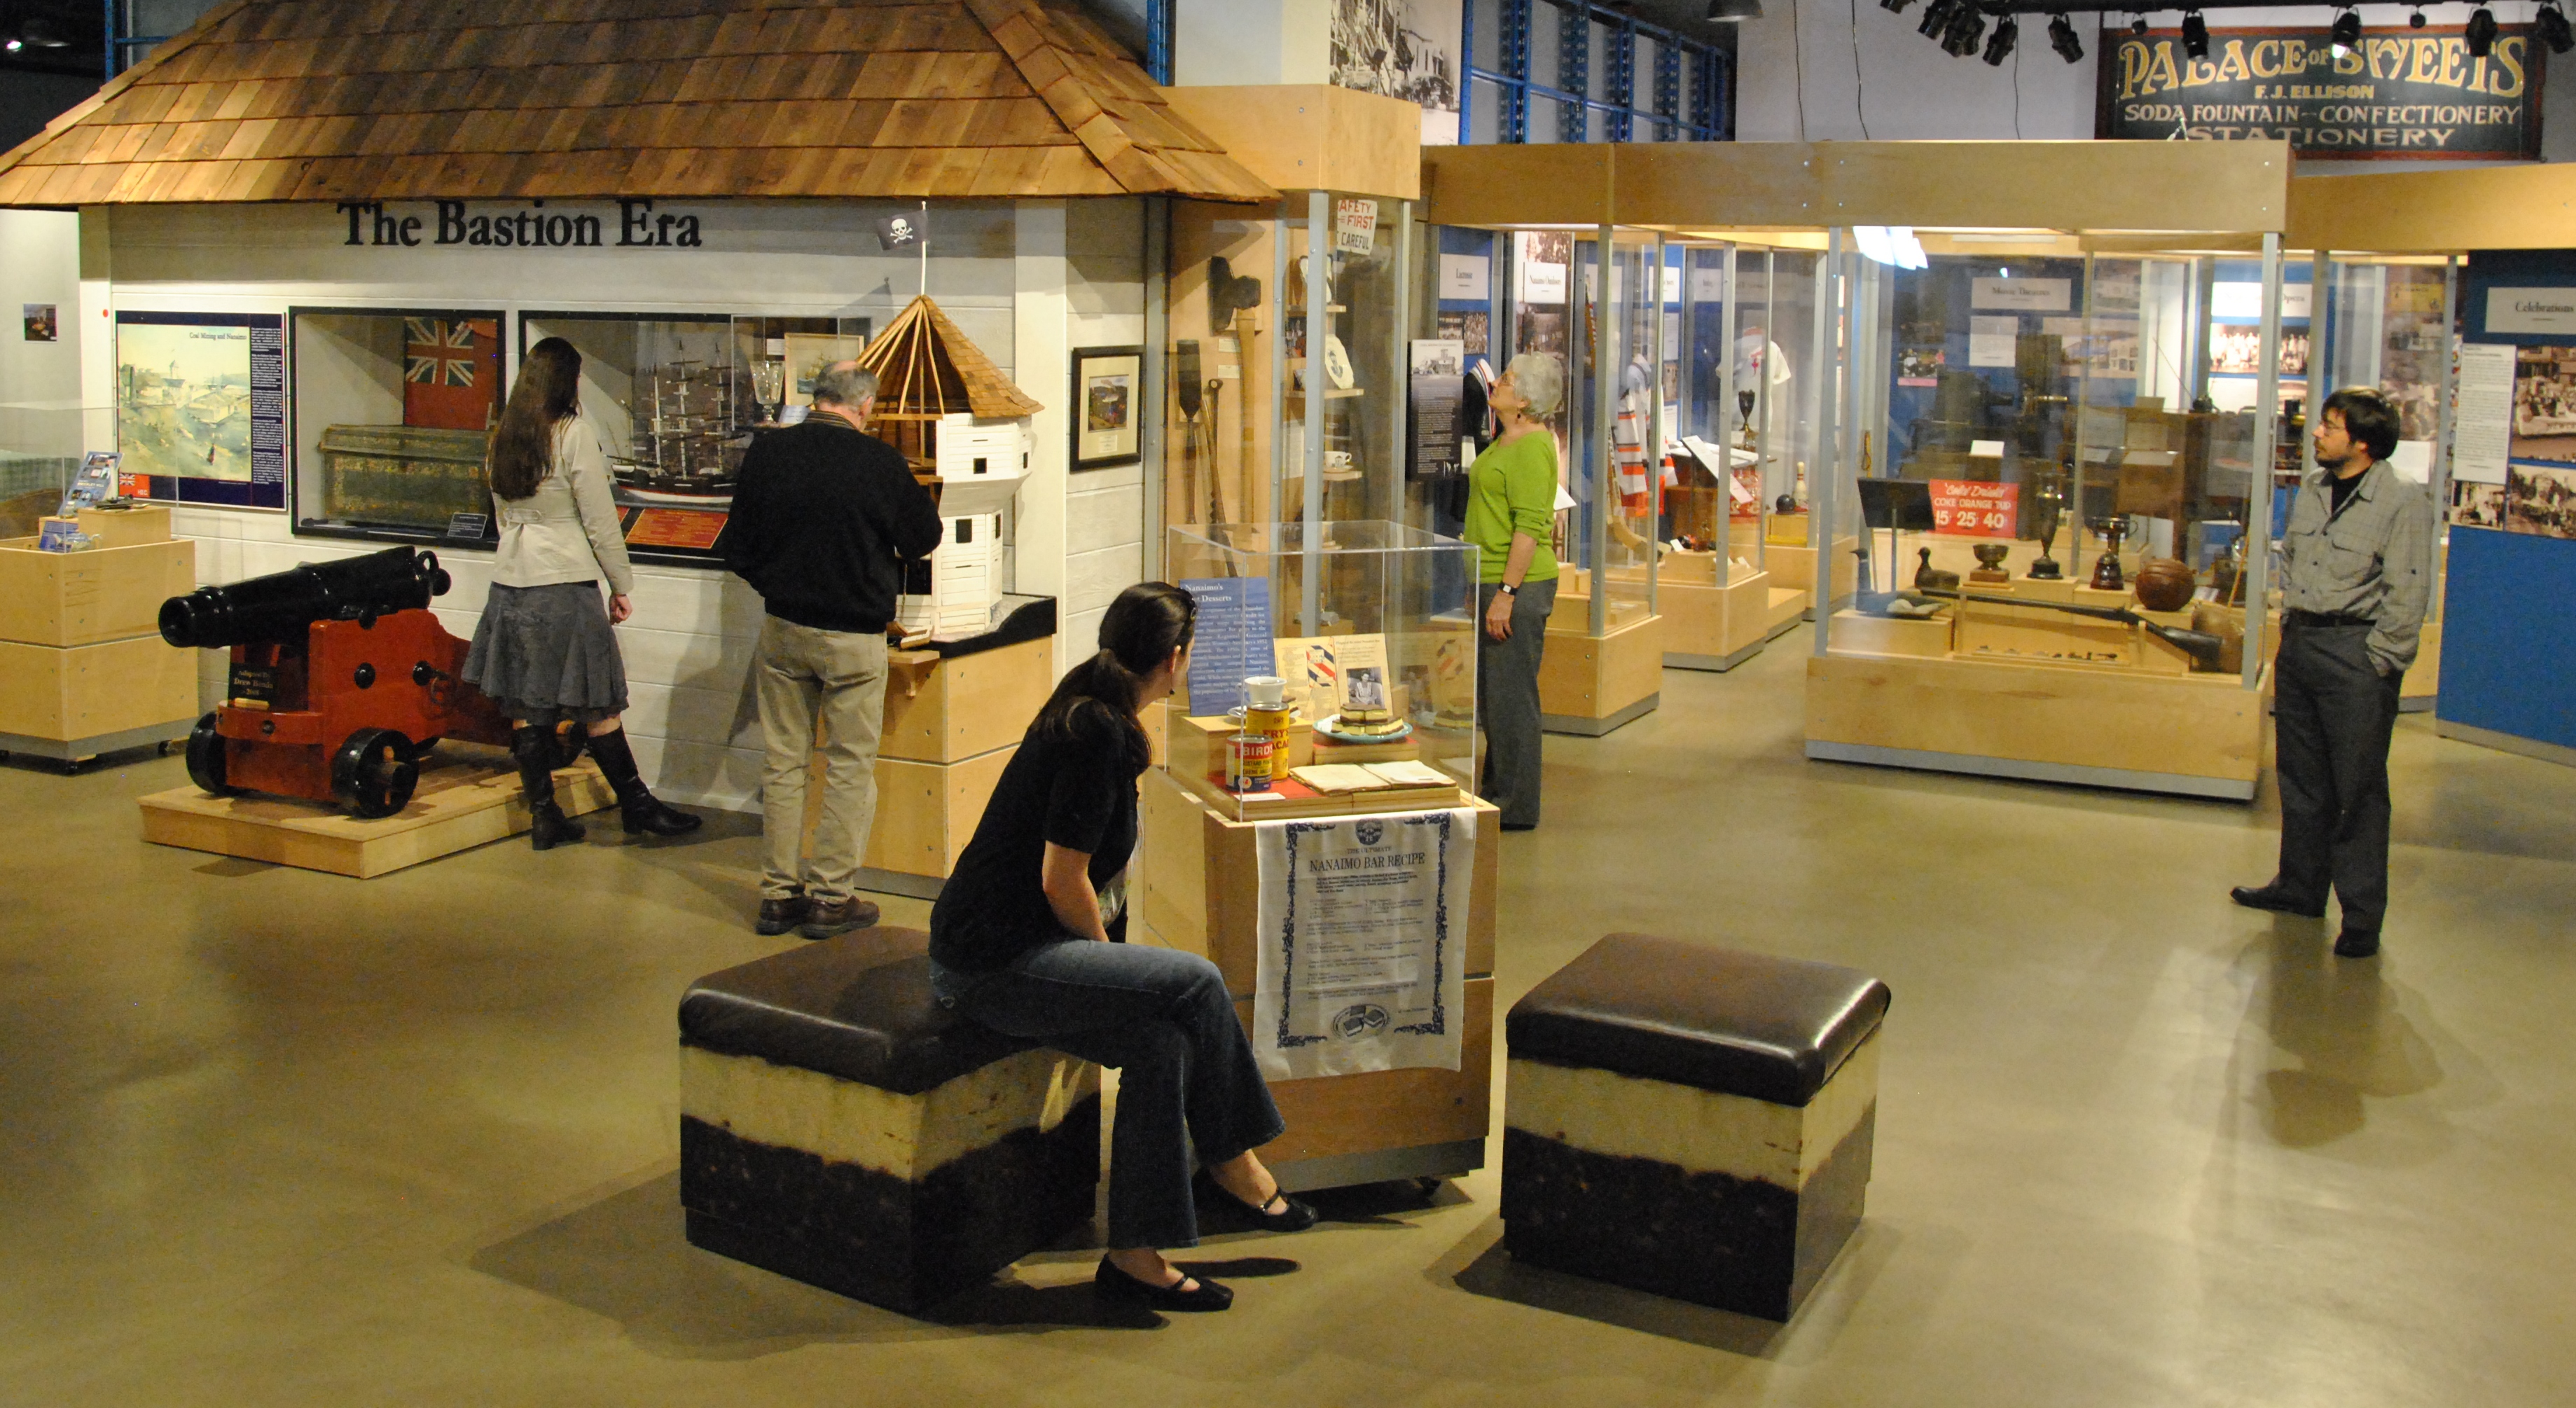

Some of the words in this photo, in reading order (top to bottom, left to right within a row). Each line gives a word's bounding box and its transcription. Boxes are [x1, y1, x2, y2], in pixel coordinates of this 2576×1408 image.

[2118, 39, 2307, 99] PALACE
[2308, 48, 2329, 65] OF
[2333, 36, 2527, 98] SWEETS
[2290, 85, 2375, 99] ELLISON
[2124, 104, 2187, 122] SODA
[2192, 104, 2299, 123] FOUNTAIN
[2319, 105, 2521, 125] CONFECTIONERY
[2187, 126, 2456, 147] STATIONERY
[1338, 200, 1371, 214] AFETY
[336, 201, 422, 247] The
[434, 197, 603, 247] Bastion
[615, 196, 702, 247] Era
[1347, 214, 1374, 230] FIRST
[1341, 232, 1369, 250] CAREFUL
[2515, 301, 2575, 312] Celebrations
[1934, 497, 1957, 507] COKE
[1959, 498, 1993, 509] ORANGE
[1185, 583, 1224, 591] Nanaimo's
[1308, 857, 1362, 872] NANAIMO
[1363, 855, 1385, 869] BAR
[1387, 852, 1426, 867] RECIPE
